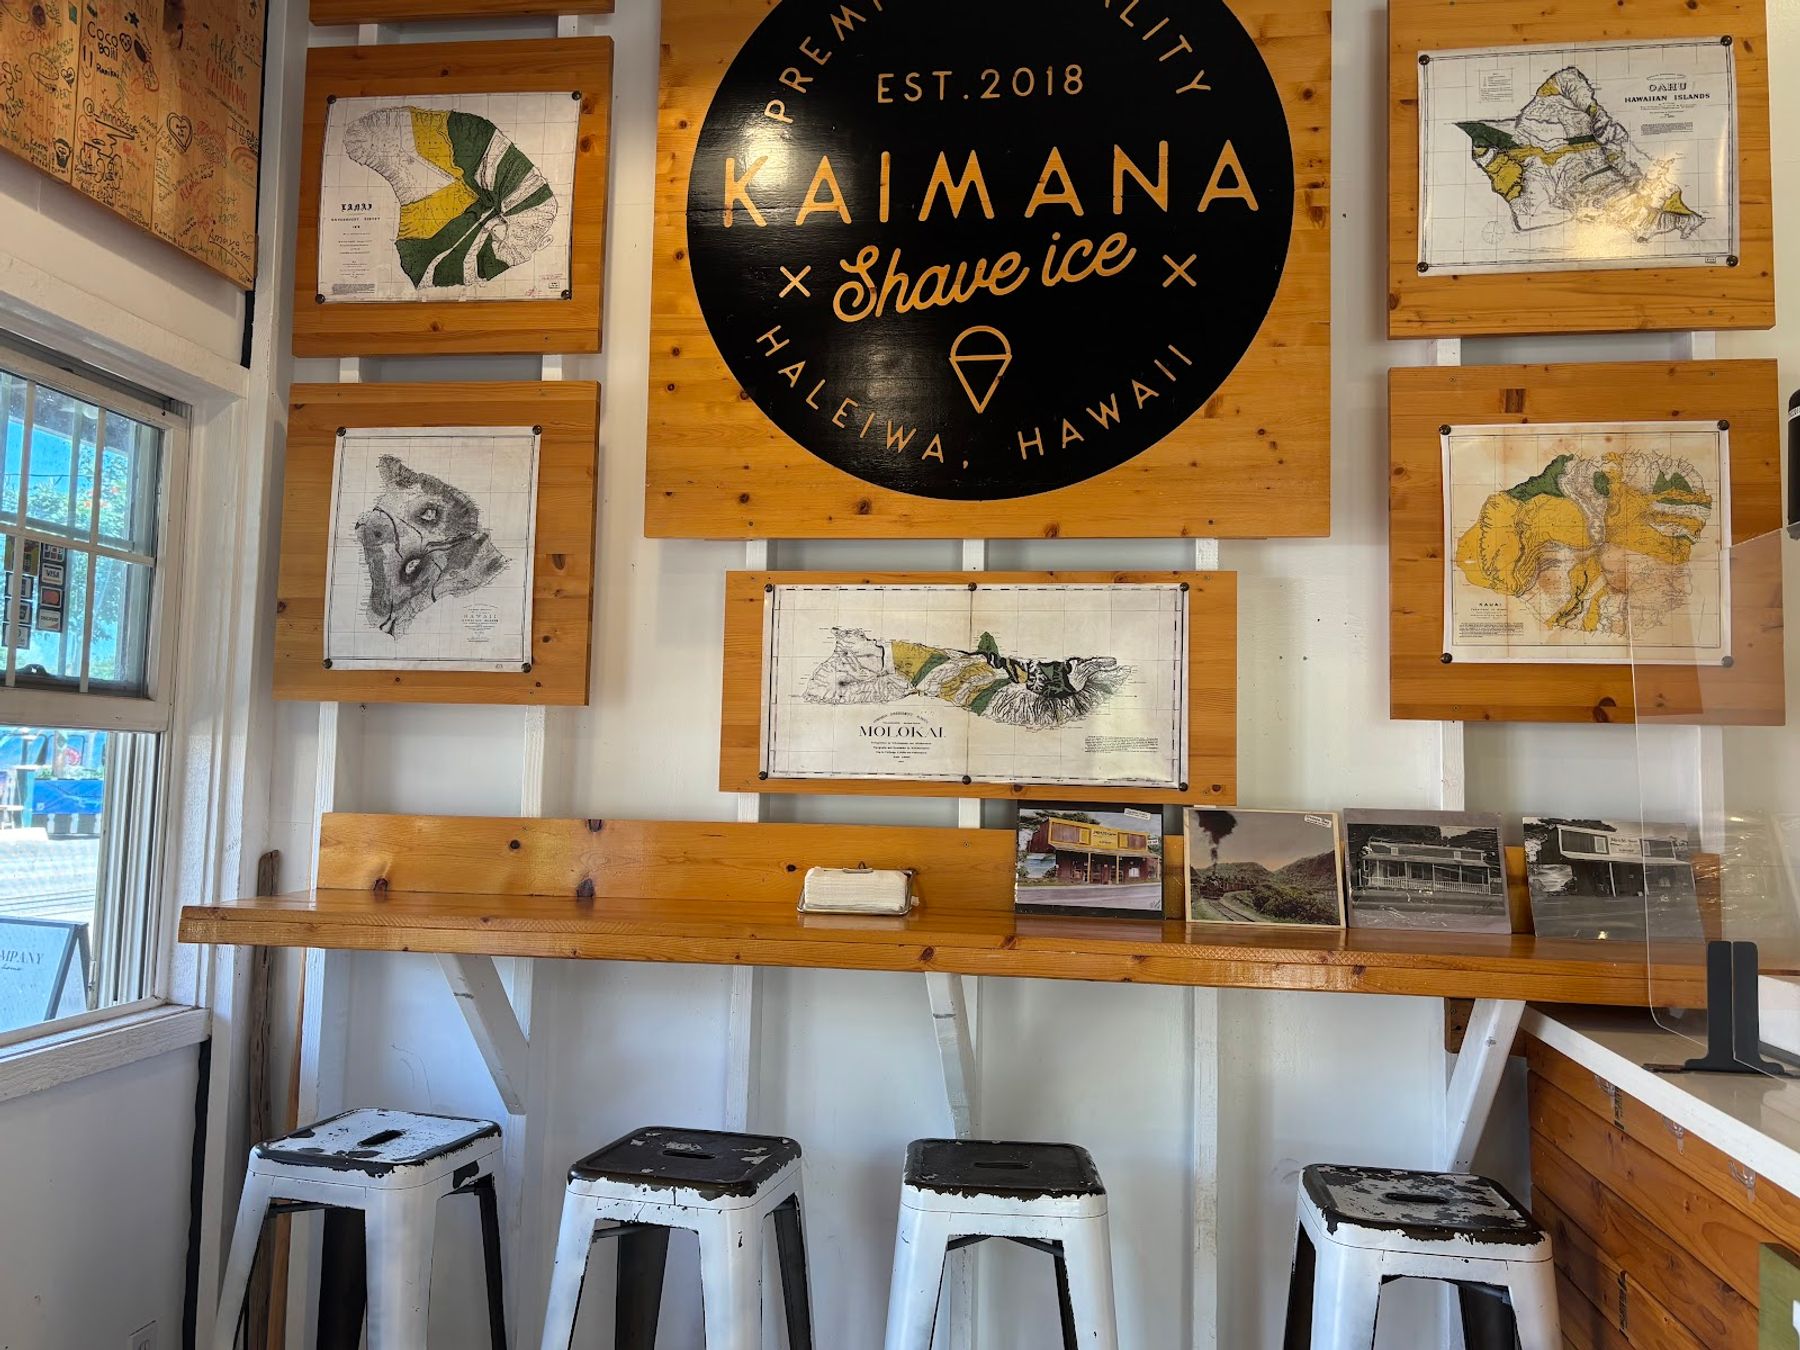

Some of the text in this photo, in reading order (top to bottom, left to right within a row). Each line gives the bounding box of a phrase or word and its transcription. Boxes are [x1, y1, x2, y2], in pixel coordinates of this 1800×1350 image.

[1104, 0, 1211, 94] LITY
[1649, 82, 1687, 92] OAHU
[1624, 93, 1711, 103] HAWAIIAN ISLANDS
[723, 139, 1260, 229] KAIMANA
[832, 231, 1138, 323] Shave ice
[1017, 344, 1193, 461] HAWAII
[46, 568, 60, 578] VISA
